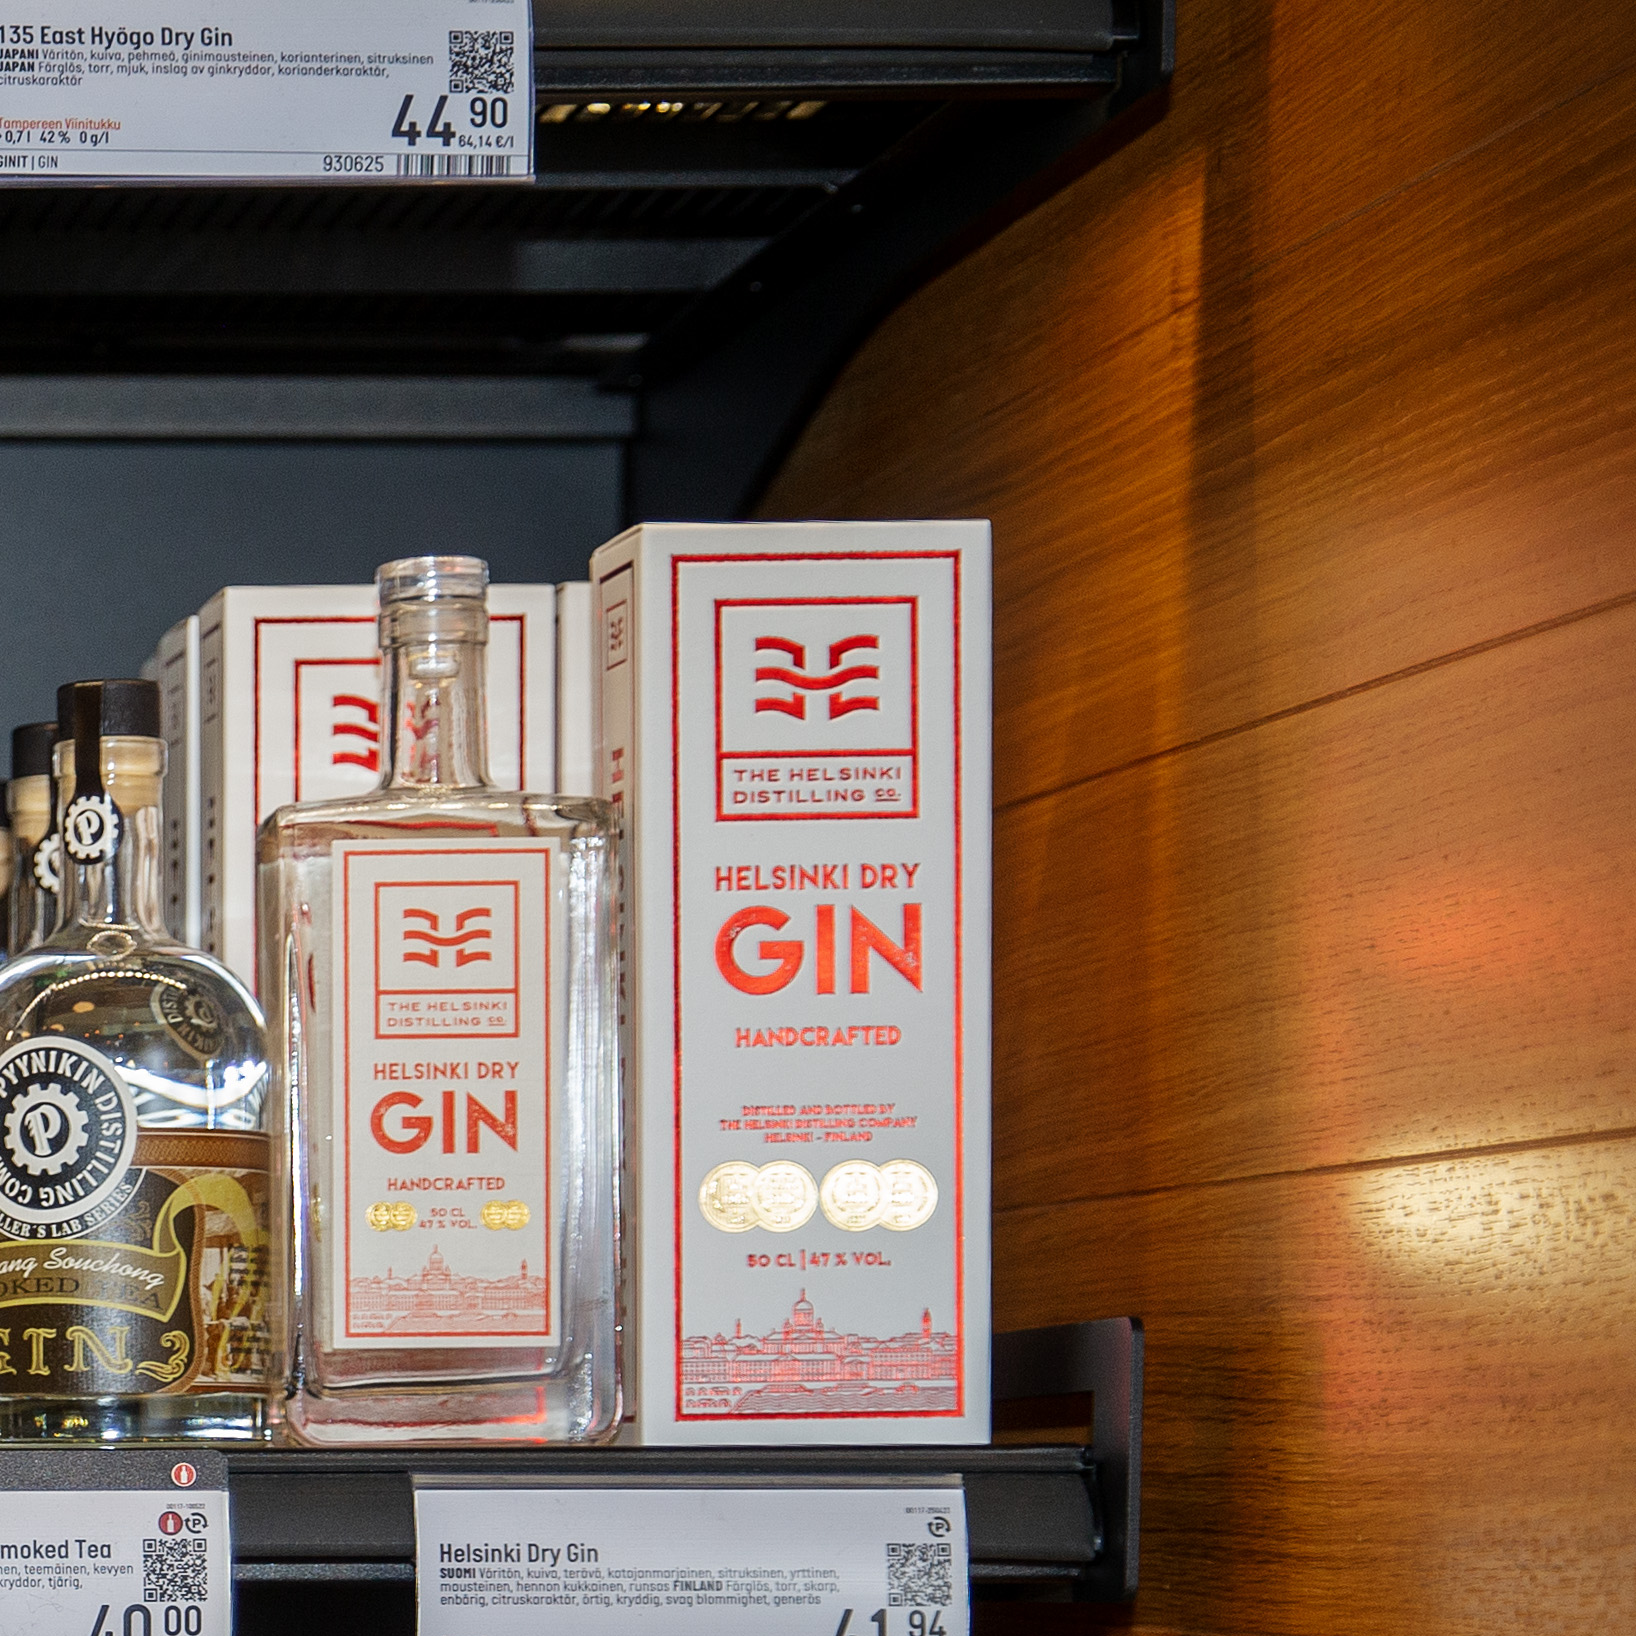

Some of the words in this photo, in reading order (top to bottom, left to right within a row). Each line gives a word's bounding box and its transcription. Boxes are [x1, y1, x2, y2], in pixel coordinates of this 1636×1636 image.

[41, 26, 85, 47] East
[91, 26, 154, 50] Hyögo
[161, 27, 195, 50] Dry
[201, 27, 232, 46] Gin
[65, 118, 121, 130] Viinitukku
[391, 94, 456, 147] 44
[470, 97, 508, 128] 90
[715, 864, 849, 891] HELSINKI
[861, 862, 920, 891] DRY
[715, 903, 923, 997] GIN
[736, 1026, 902, 1048] HANDCRAFTED
[373, 1062, 469, 1079] HELSINKI
[477, 1062, 519, 1079] DRY
[370, 1090, 519, 1155] GIN
[387, 1177, 505, 1192] HANDCRAFTED
[74, 1539, 111, 1559] Tea
[440, 1543, 520, 1563] Helsinki
[528, 1543, 561, 1567] Dry
[567, 1543, 598, 1562] Gin
[164, 1605, 202, 1636] 00
